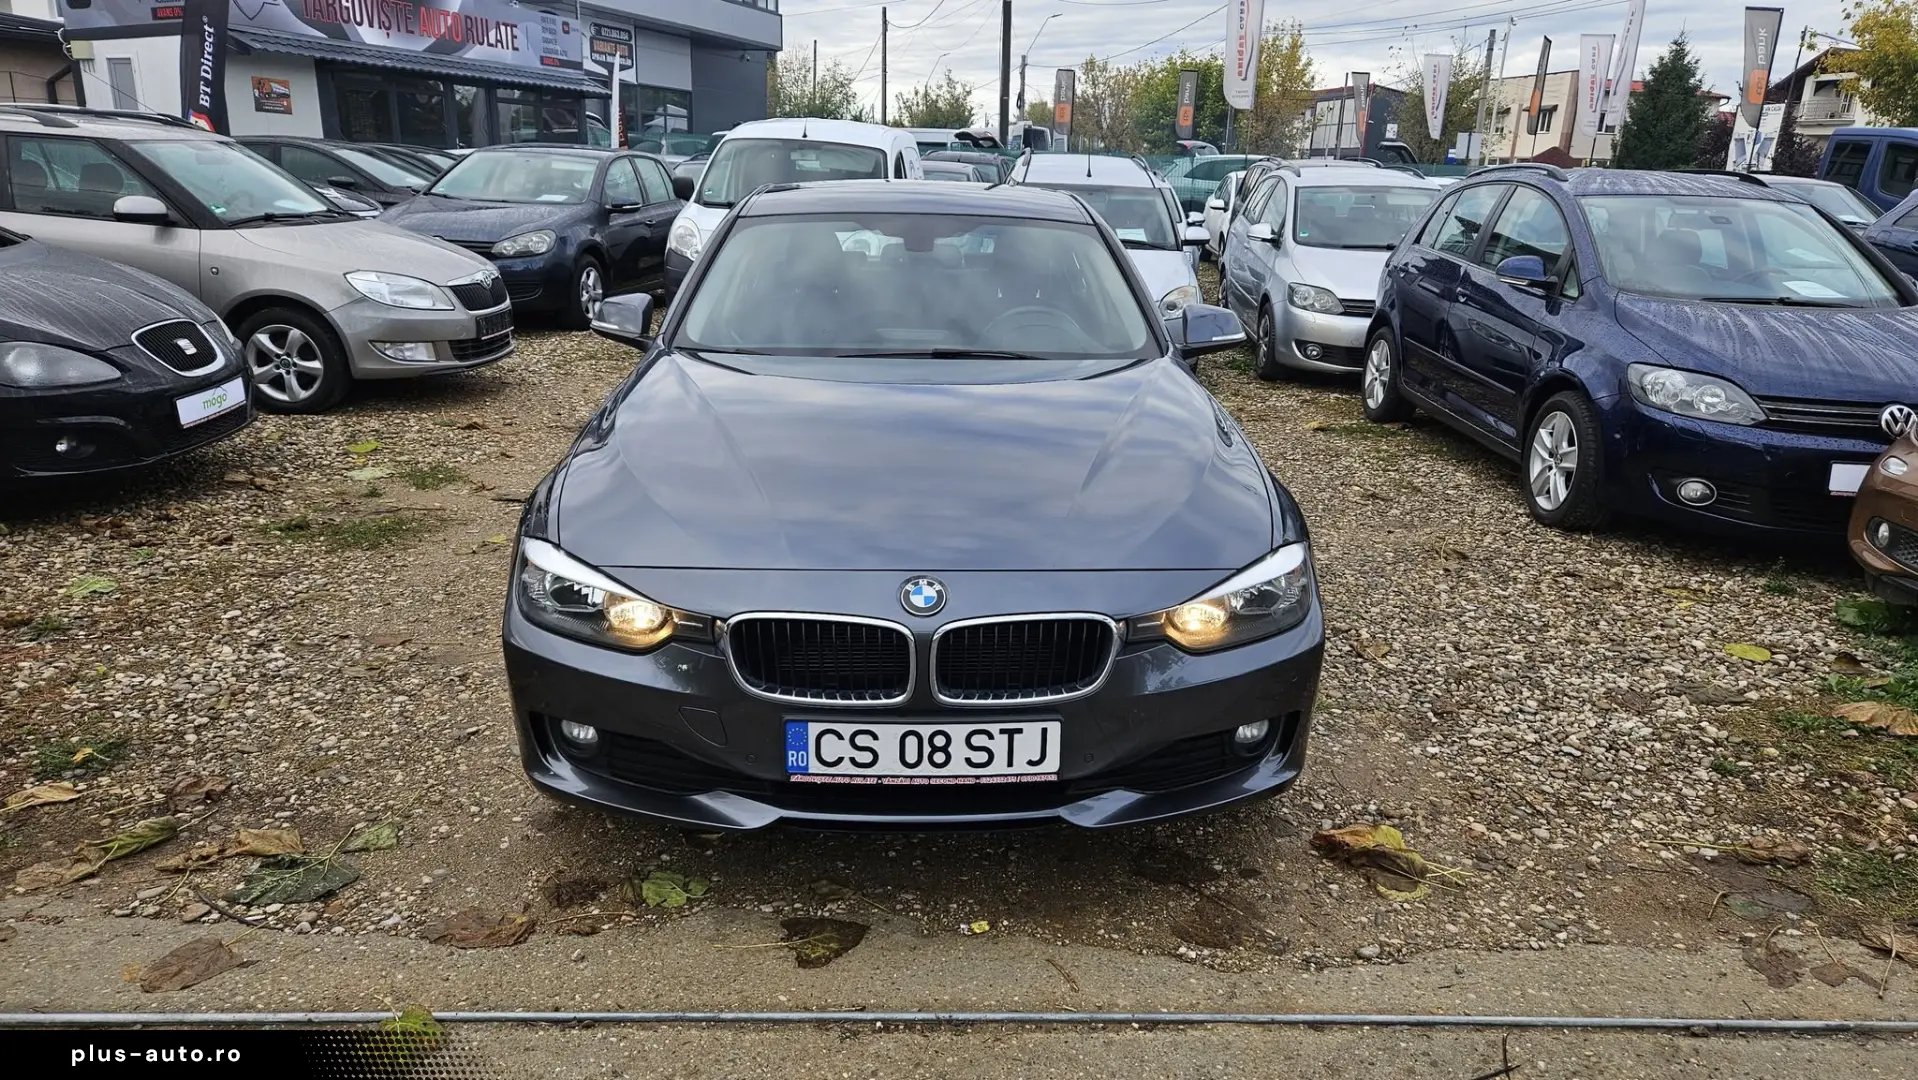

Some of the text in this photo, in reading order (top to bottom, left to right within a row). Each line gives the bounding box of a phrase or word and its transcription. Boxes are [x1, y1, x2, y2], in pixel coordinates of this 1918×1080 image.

[420, 5, 463, 43] AUTO
[464, 14, 520, 52] RULATE
[199, 81, 212, 109] BT
[202, 393, 228, 410] mogo
[905, 579, 943, 591] BMW
[788, 751, 807, 767] RO
[814, 727, 1049, 769] CS 08 STJ
